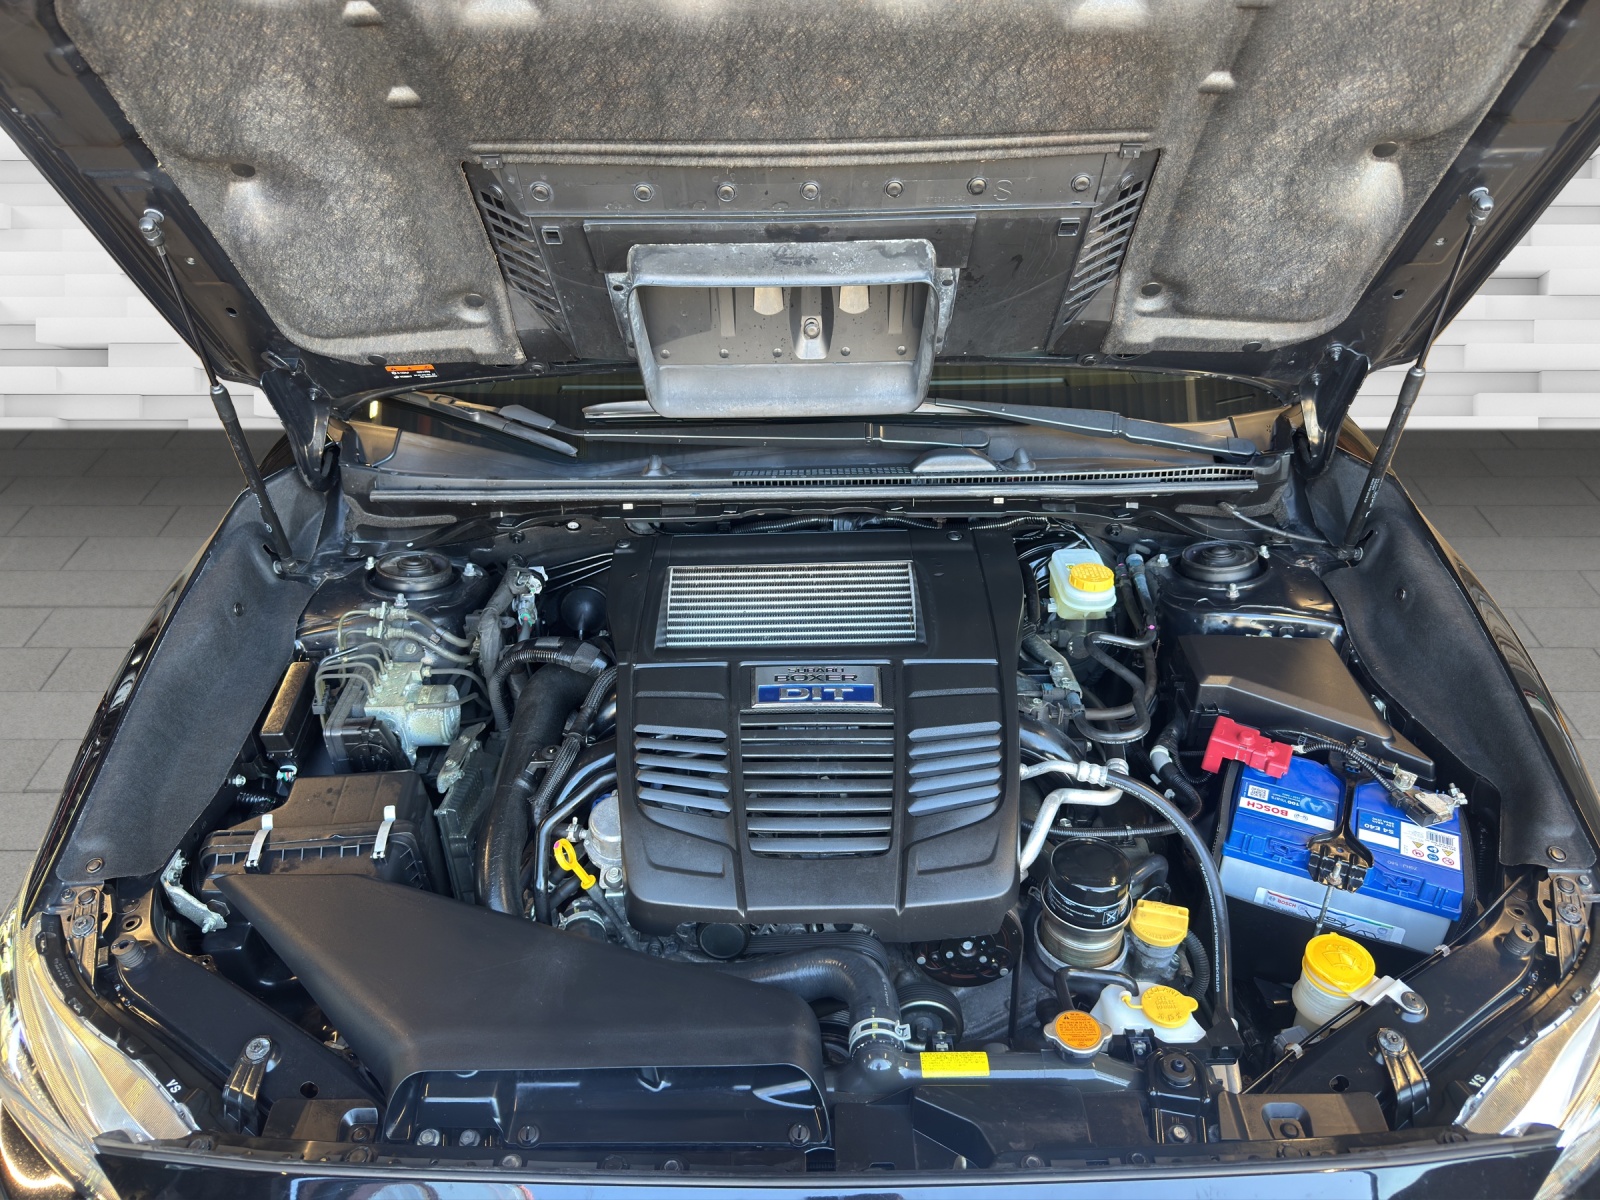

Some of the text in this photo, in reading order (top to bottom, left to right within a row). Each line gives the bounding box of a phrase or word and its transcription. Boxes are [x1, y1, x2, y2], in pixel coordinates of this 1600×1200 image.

[774, 673, 858, 682] BOXER
[779, 687, 854, 700] DIT
[1247, 800, 1289, 817] BOSCH
[1277, 898, 1297, 909] BOSCH
[166, 1078, 181, 1093] VS
[1468, 1074, 1486, 1087] VS
